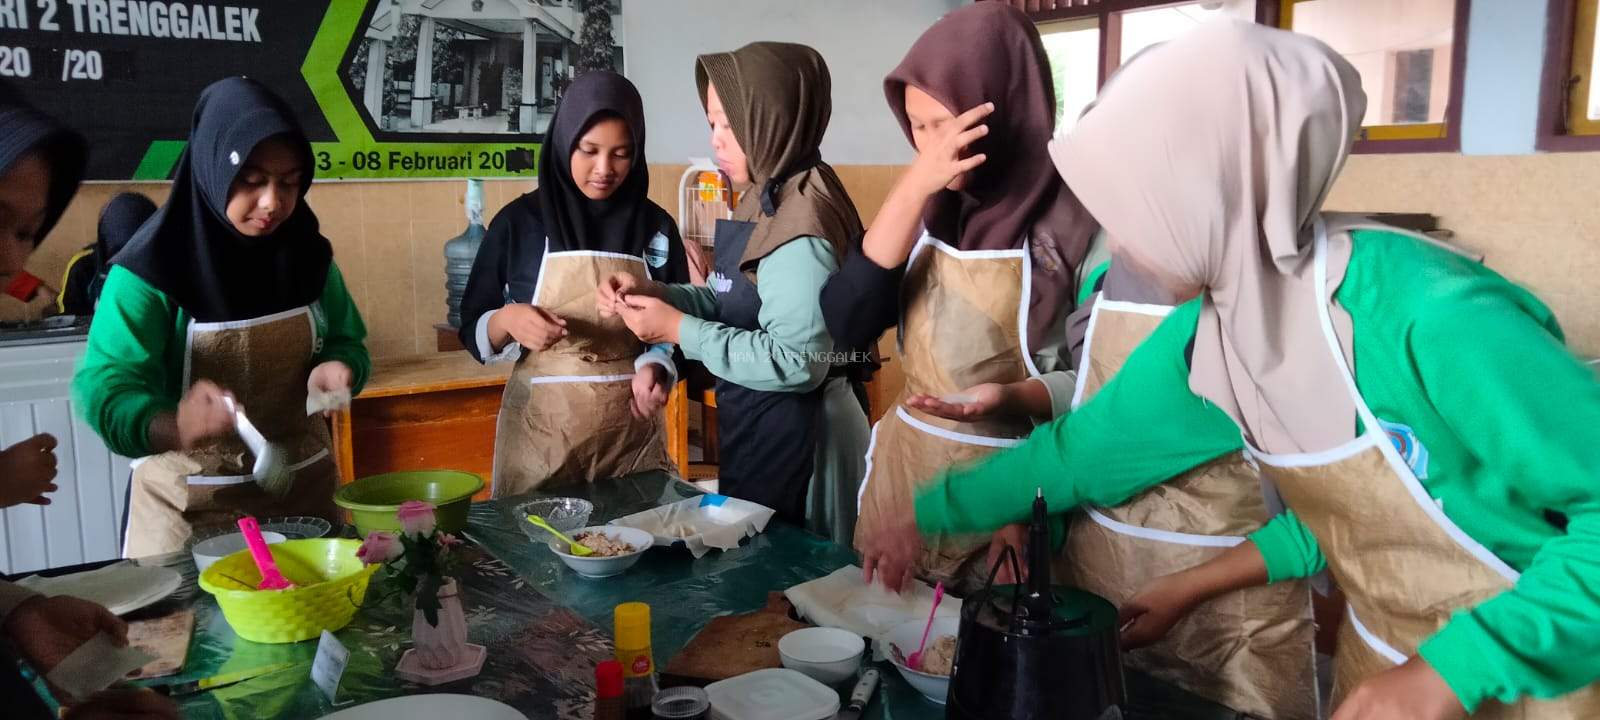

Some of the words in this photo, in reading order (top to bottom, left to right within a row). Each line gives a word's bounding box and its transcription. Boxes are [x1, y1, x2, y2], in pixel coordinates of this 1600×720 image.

[38, 0, 60, 31] 2
[67, 0, 261, 42] TRENGGALEK
[352, 151, 381, 170] 08
[388, 151, 473, 170] Februari
